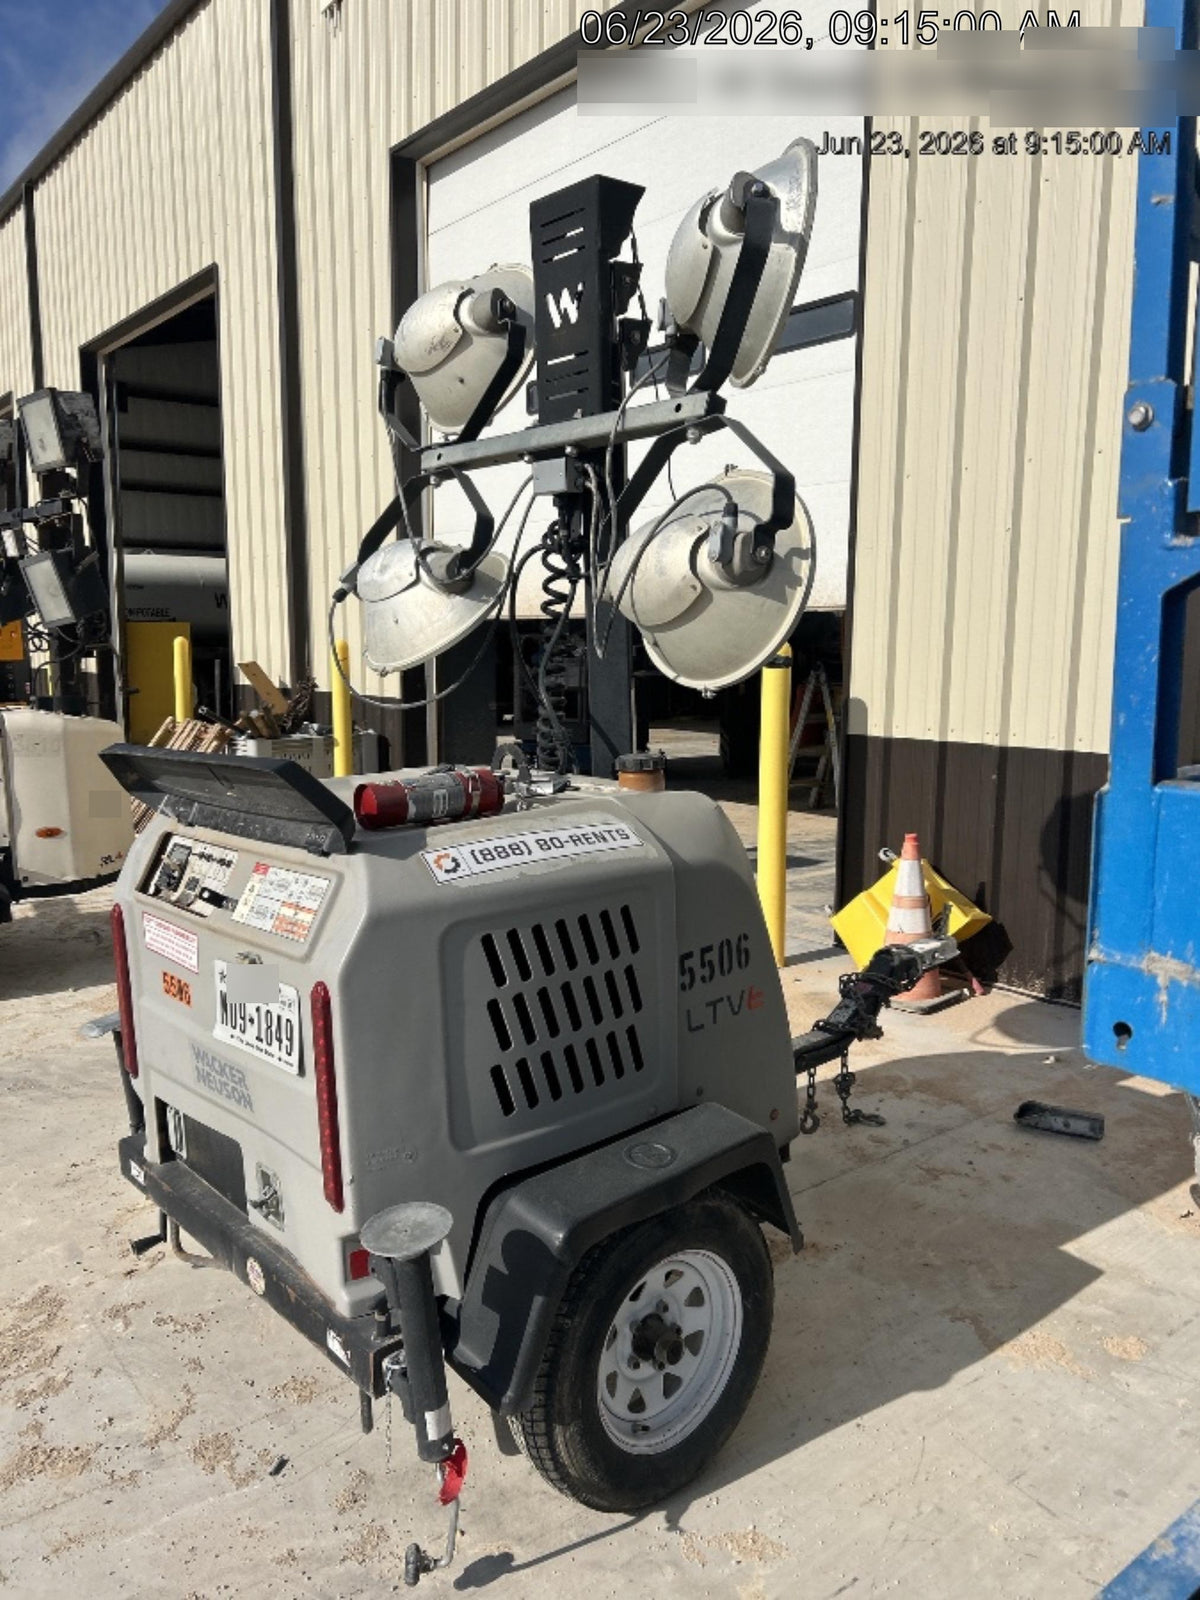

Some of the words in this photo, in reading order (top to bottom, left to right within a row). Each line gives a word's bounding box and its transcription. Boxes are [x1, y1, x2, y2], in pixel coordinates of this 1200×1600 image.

[545, 281, 585, 329] W
[470, 840, 533, 865] (888)
[535, 828, 631, 851] 80-RENTS
[679, 932, 750, 992] 5506
[255, 1005, 294, 1057] 1849
[191, 1043, 250, 1092] WACKER
[195, 1064, 255, 1113] NEUSON
